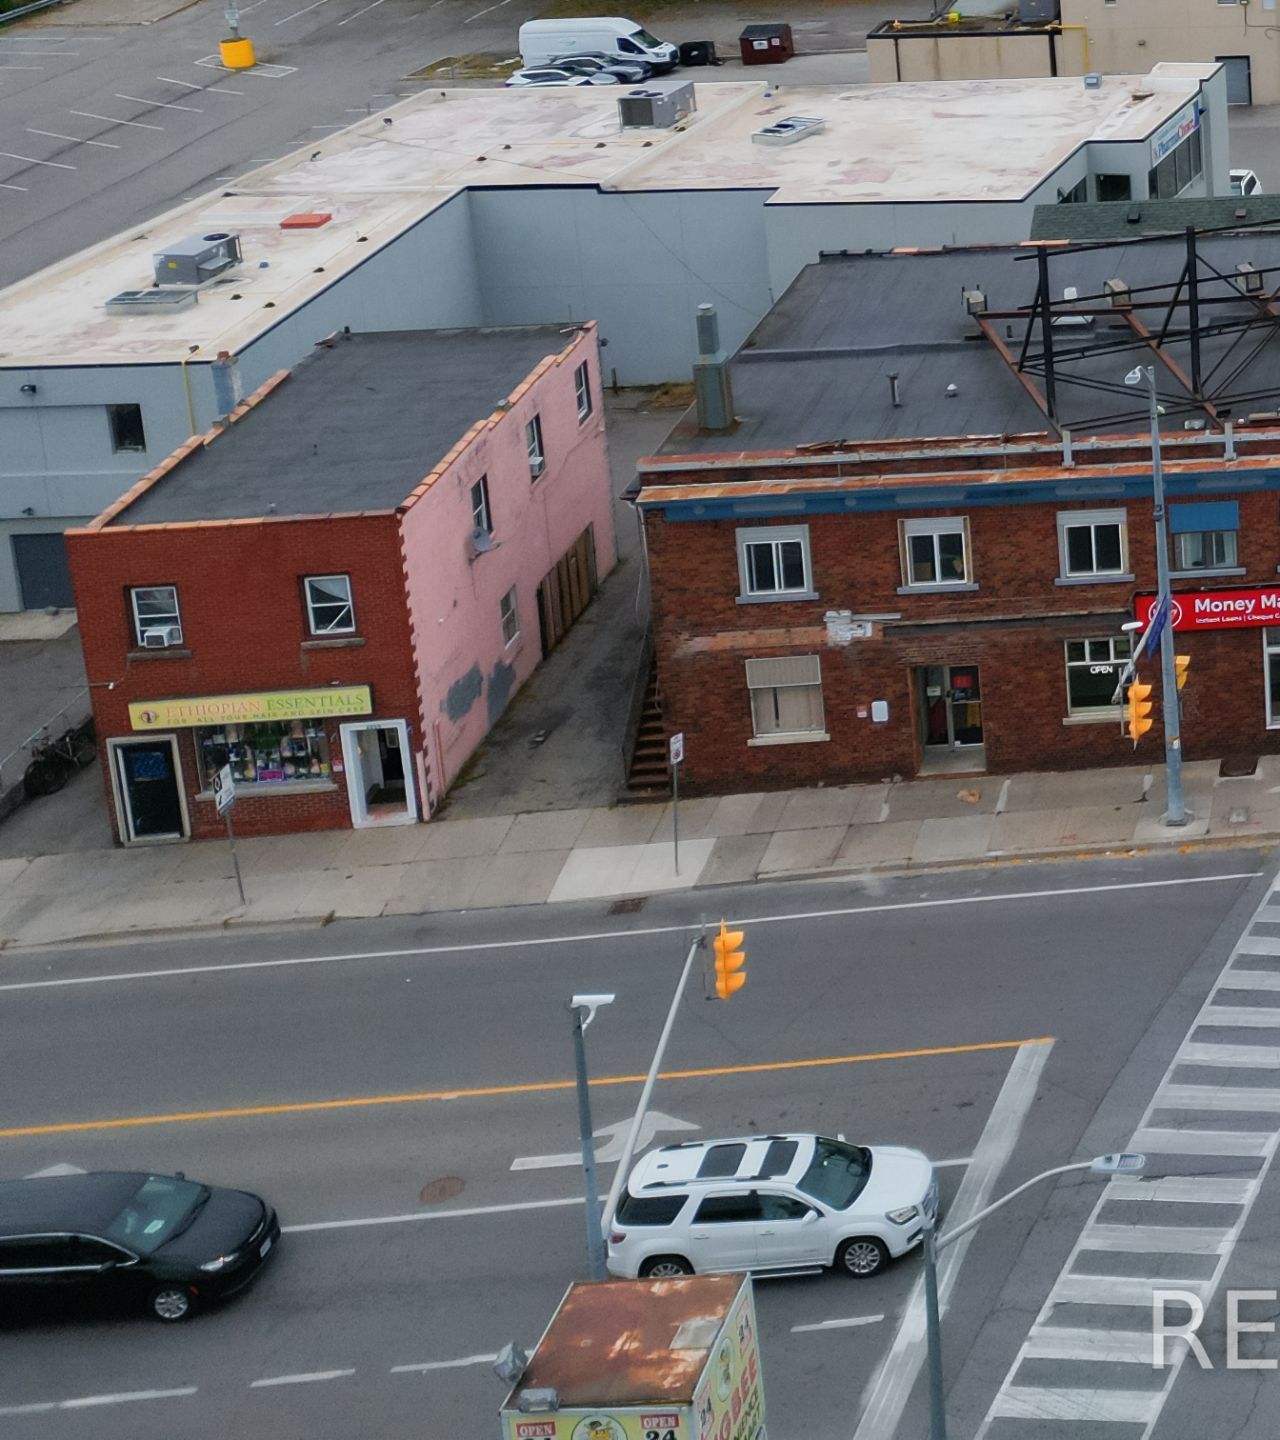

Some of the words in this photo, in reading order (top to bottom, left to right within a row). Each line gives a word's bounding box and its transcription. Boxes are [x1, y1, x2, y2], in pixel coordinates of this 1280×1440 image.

[1194, 597, 1258, 613] Money
[1090, 665, 1114, 675] OPEN
[167, 700, 261, 718] ETHIOPIAN
[266, 693, 364, 711] ESSENTIALS
[220, 714, 246, 722] YOUR
[643, 1416, 676, 1428] OPEN
[519, 1424, 553, 1436] OPEN
